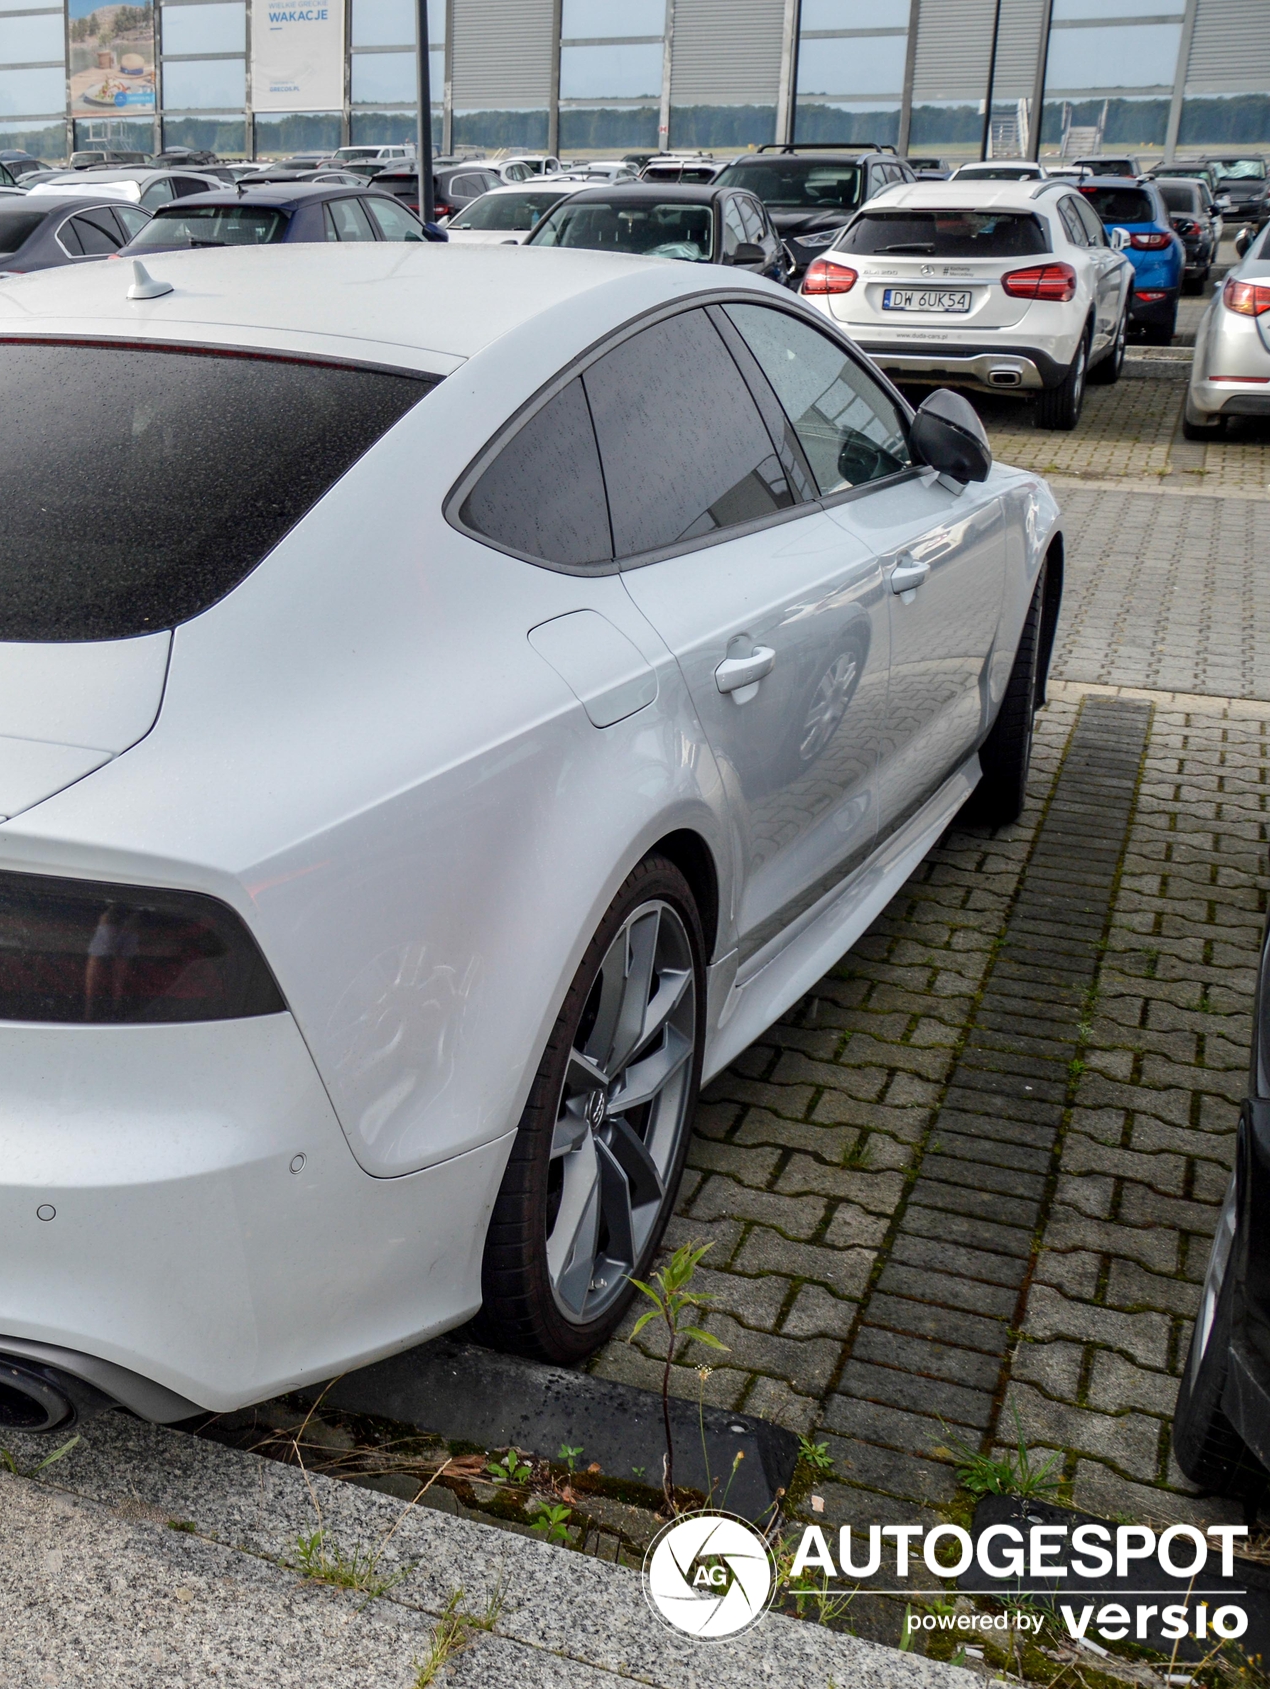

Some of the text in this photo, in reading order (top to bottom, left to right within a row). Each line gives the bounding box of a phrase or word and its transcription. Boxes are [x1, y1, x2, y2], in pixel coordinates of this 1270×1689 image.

[268, 9, 328, 22] WAKACJE
[894, 292, 966, 308] DW 6UK54
